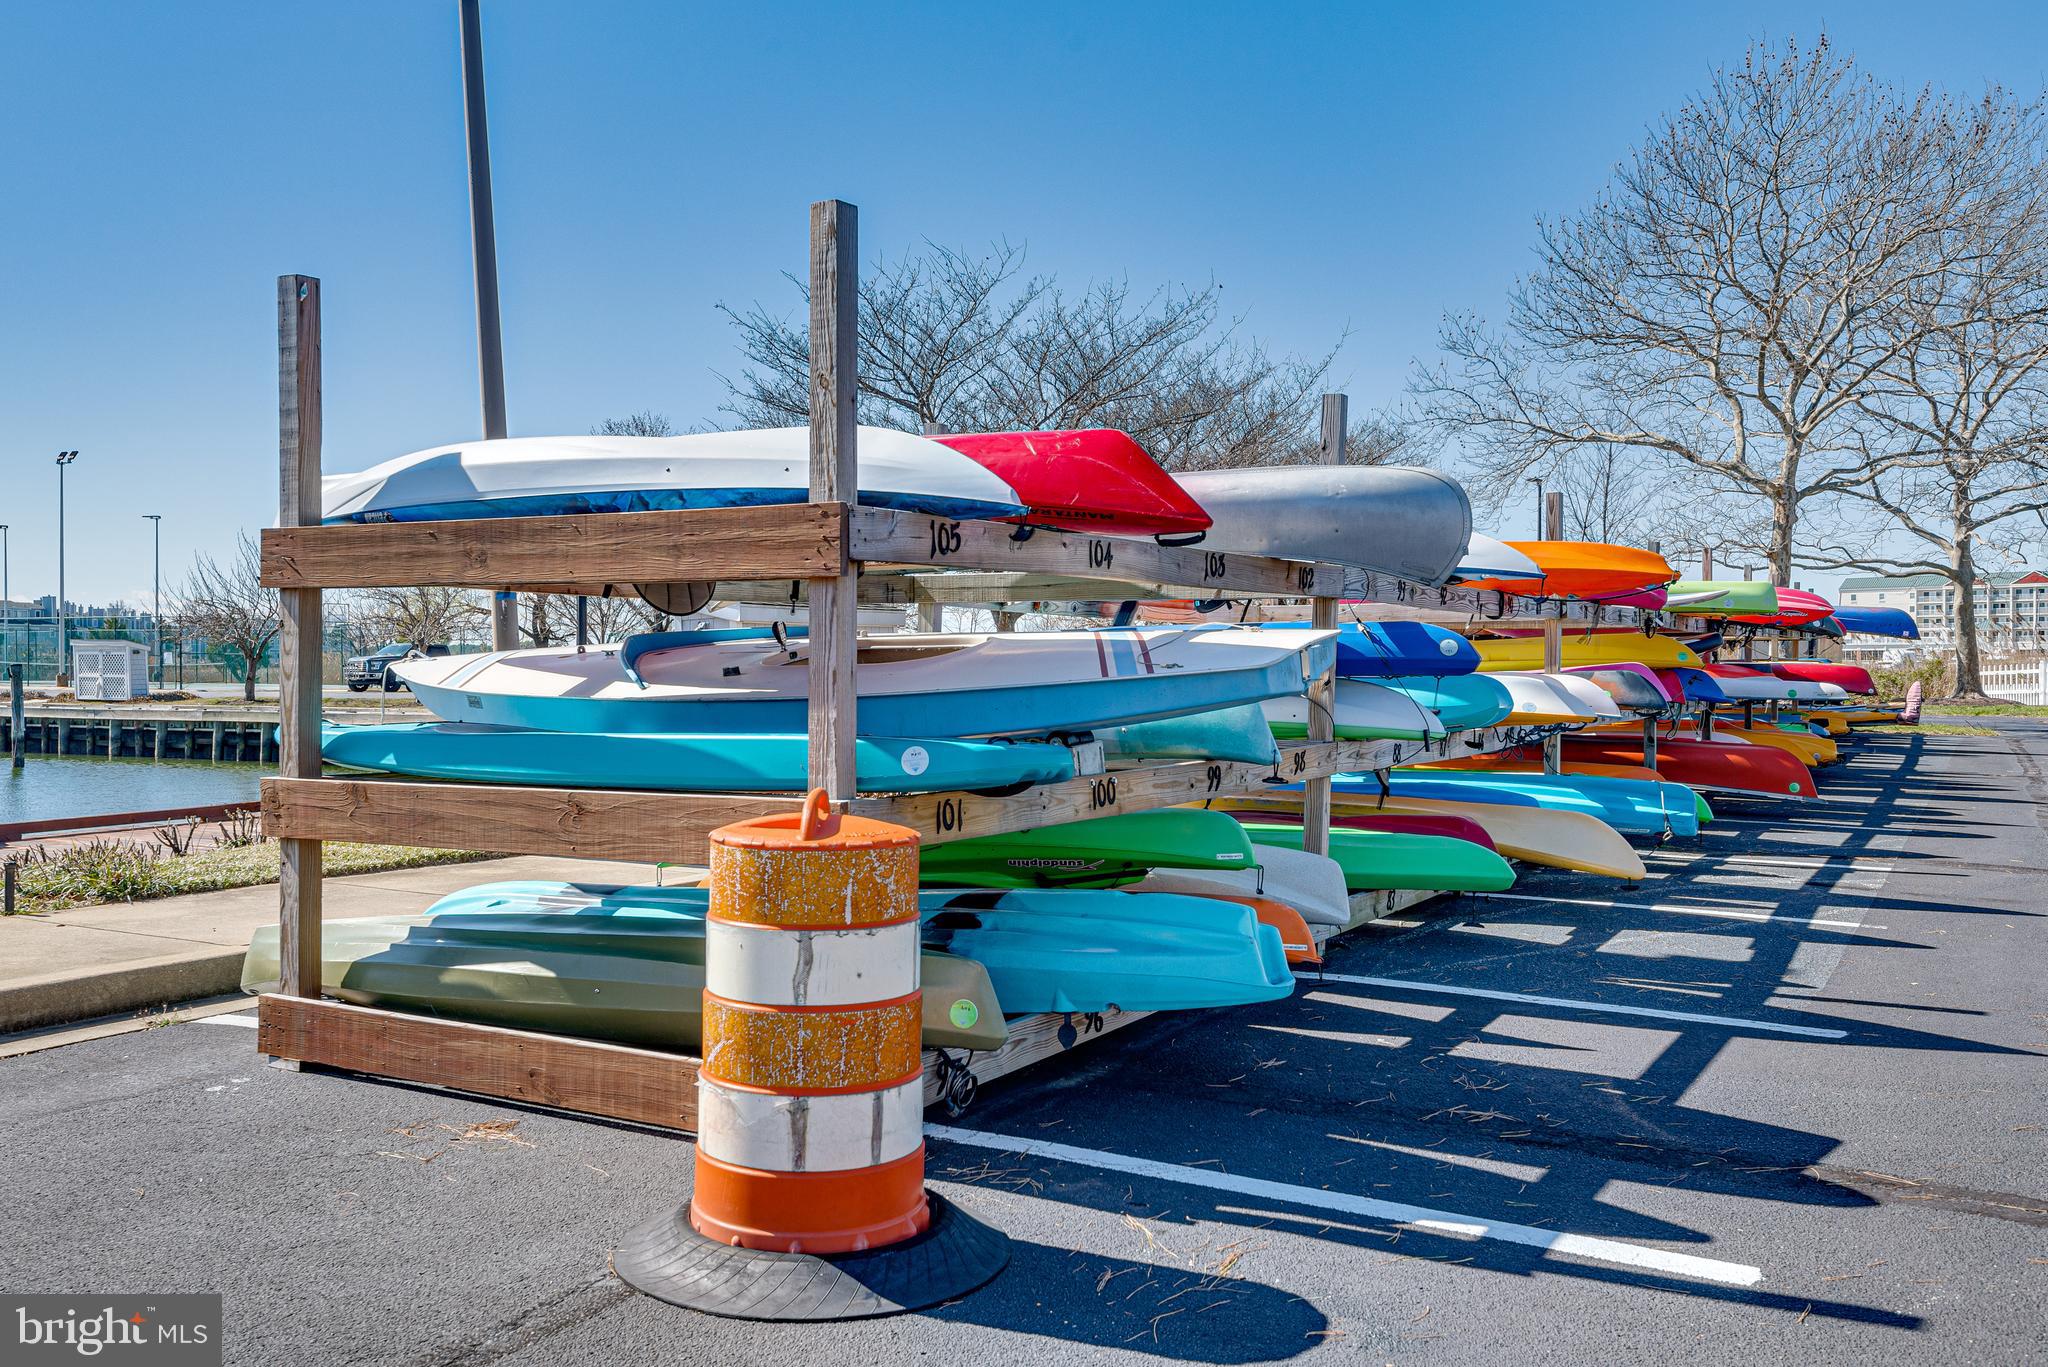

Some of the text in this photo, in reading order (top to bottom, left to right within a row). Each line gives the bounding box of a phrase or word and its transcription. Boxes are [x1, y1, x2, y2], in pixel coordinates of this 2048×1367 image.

[930, 519, 962, 560] 105
[1088, 539, 1114, 570] 104
[1204, 551, 1226, 582] 103
[1298, 566, 1314, 590] 102
[1293, 750, 1306, 776] 98
[1392, 743, 1402, 764] 88
[1207, 765, 1222, 792] 99
[1092, 777, 1117, 810] 100
[936, 798, 963, 835] 101
[1007, 857, 1085, 868] sundolphin
